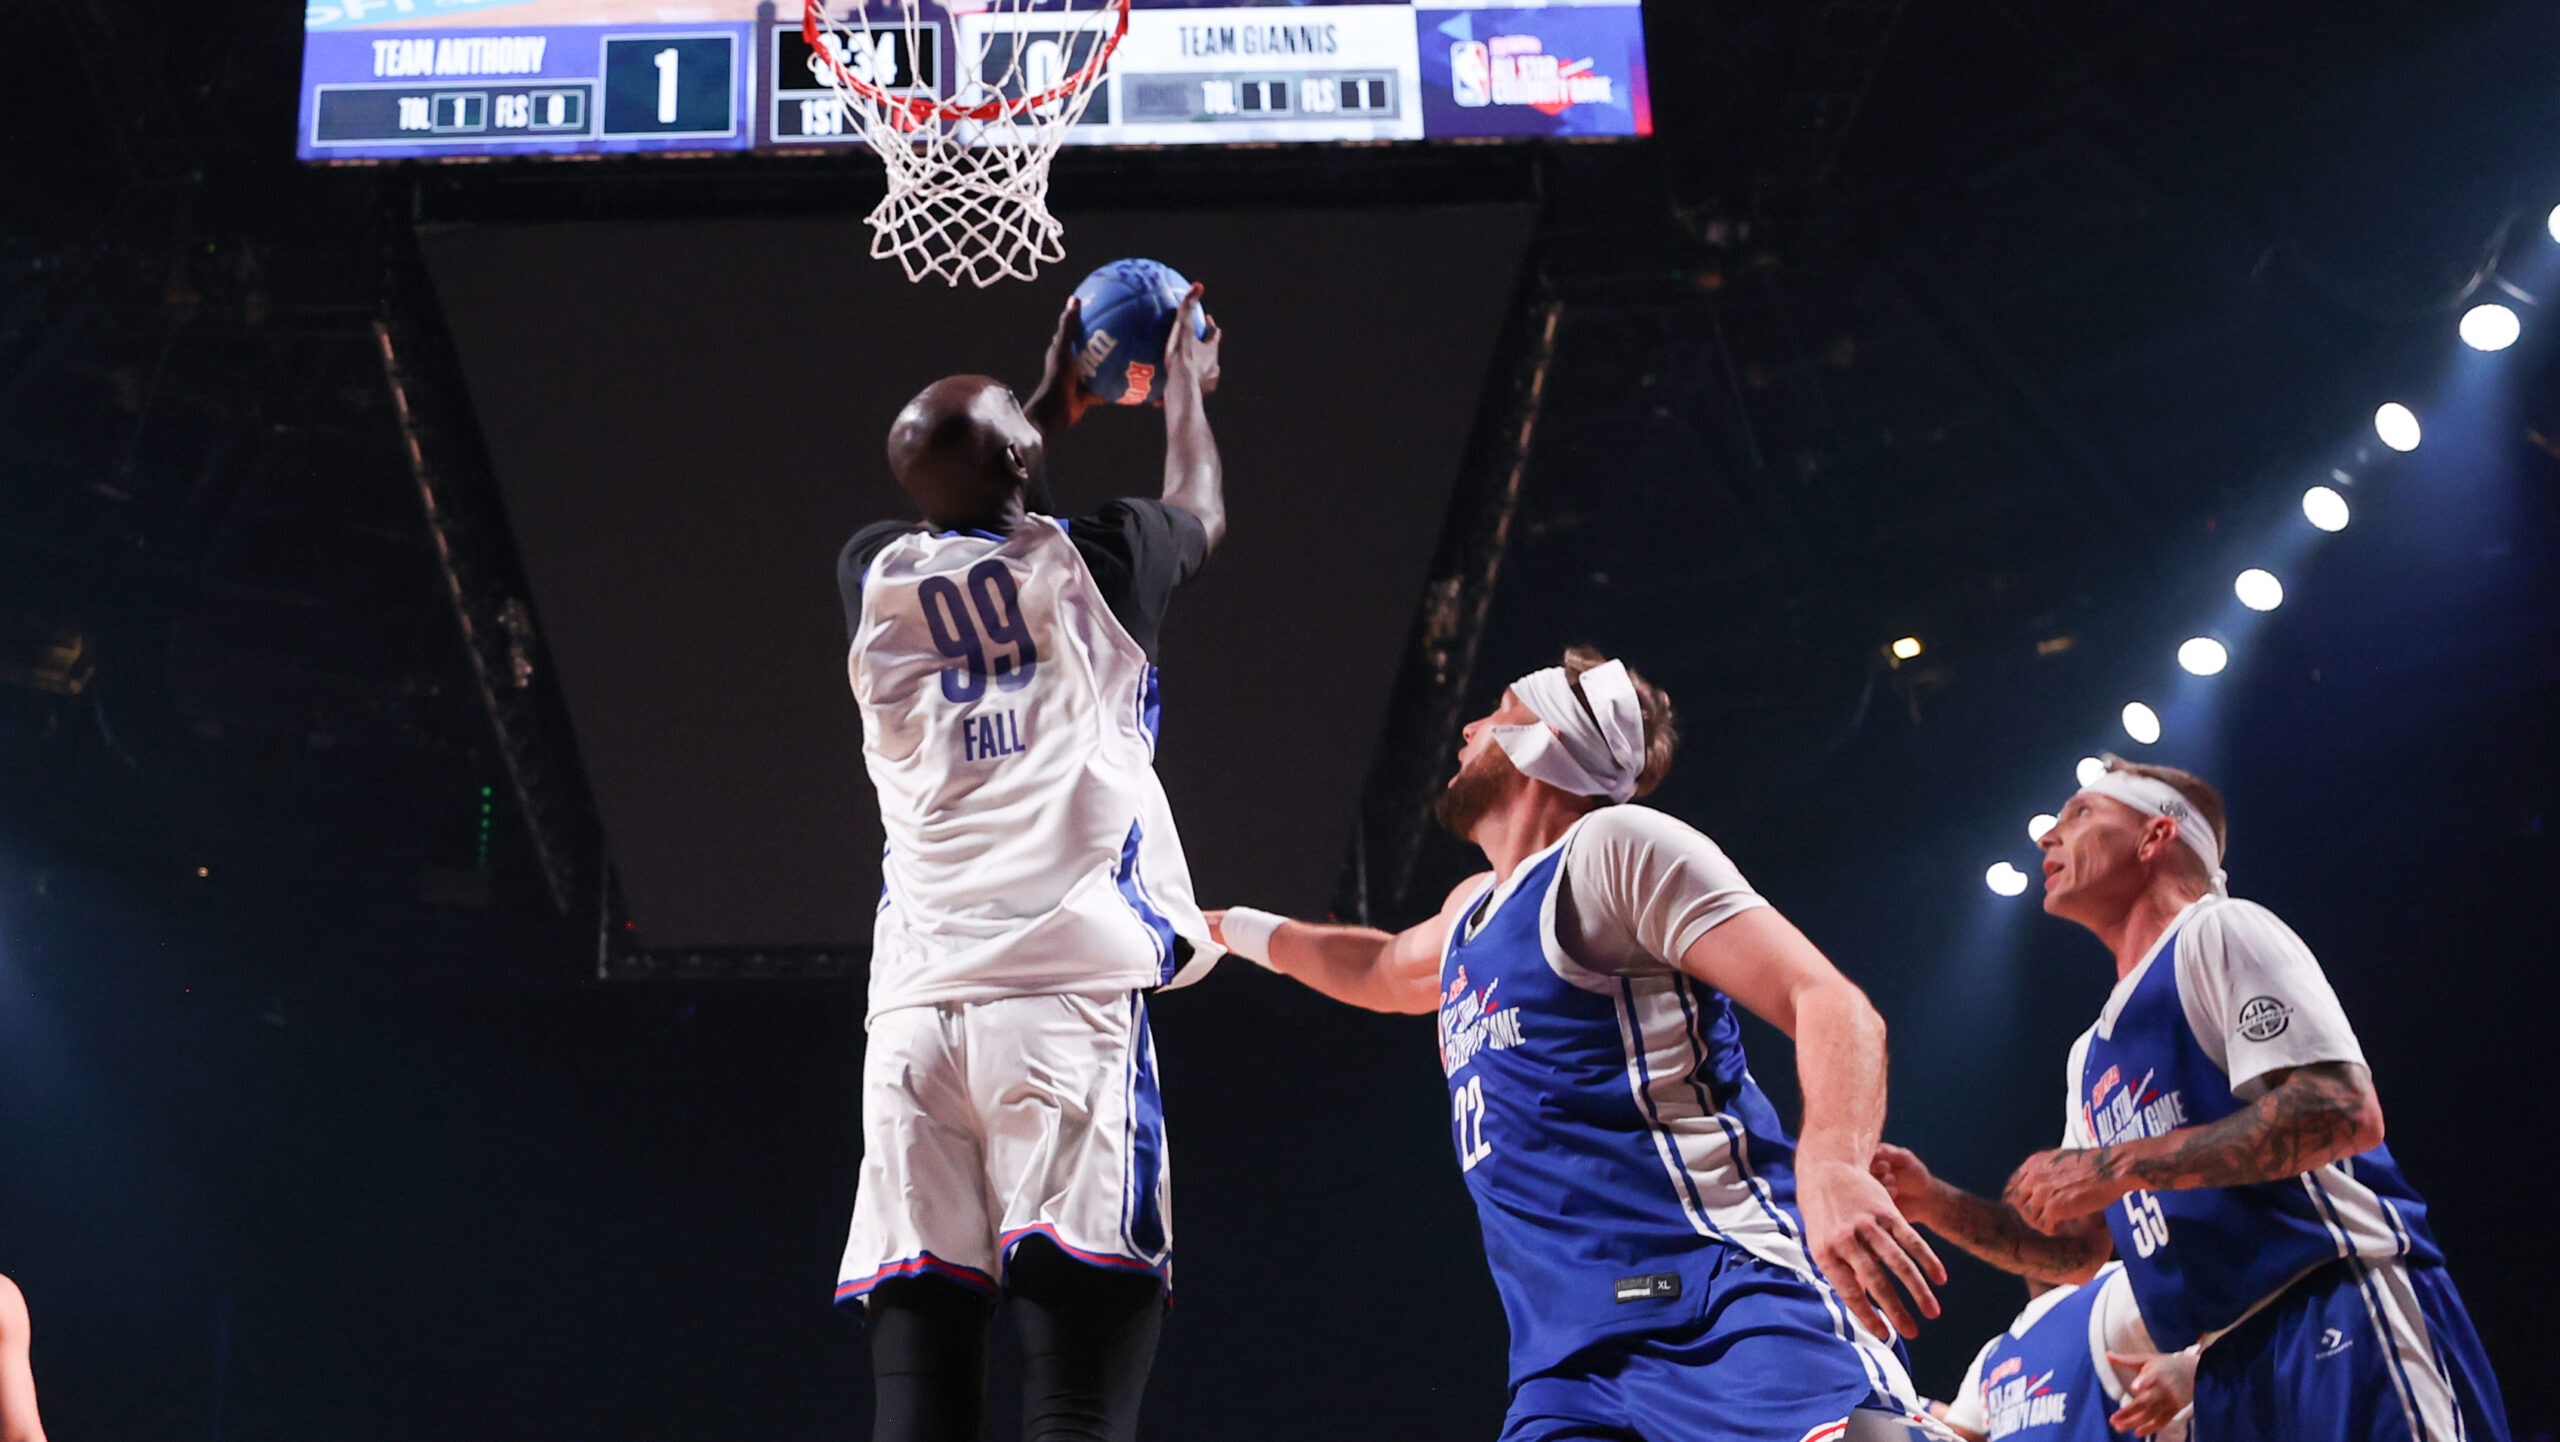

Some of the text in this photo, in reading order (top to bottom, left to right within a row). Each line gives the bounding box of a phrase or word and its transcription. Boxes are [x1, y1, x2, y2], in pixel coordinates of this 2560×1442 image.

[372, 36, 547, 77] TEAM ANTHONY
[1179, 23, 1338, 57] TEAM GIANNIS
[654, 47, 679, 124] 1
[1258, 80, 1271, 112] 1
[1301, 78, 1335, 112] FLS
[1357, 78, 1369, 111] 1
[398, 96, 431, 130] TOL
[453, 96, 466, 128] 1
[495, 94, 528, 128] FLS
[801, 98, 843, 135] 1ST
[917, 558, 1038, 703] 99
[963, 709, 1026, 762] FALL
[1454, 1075, 1492, 1173] 22
[2122, 1188, 2170, 1259] 55
[1657, 1280, 1672, 1290] XL
